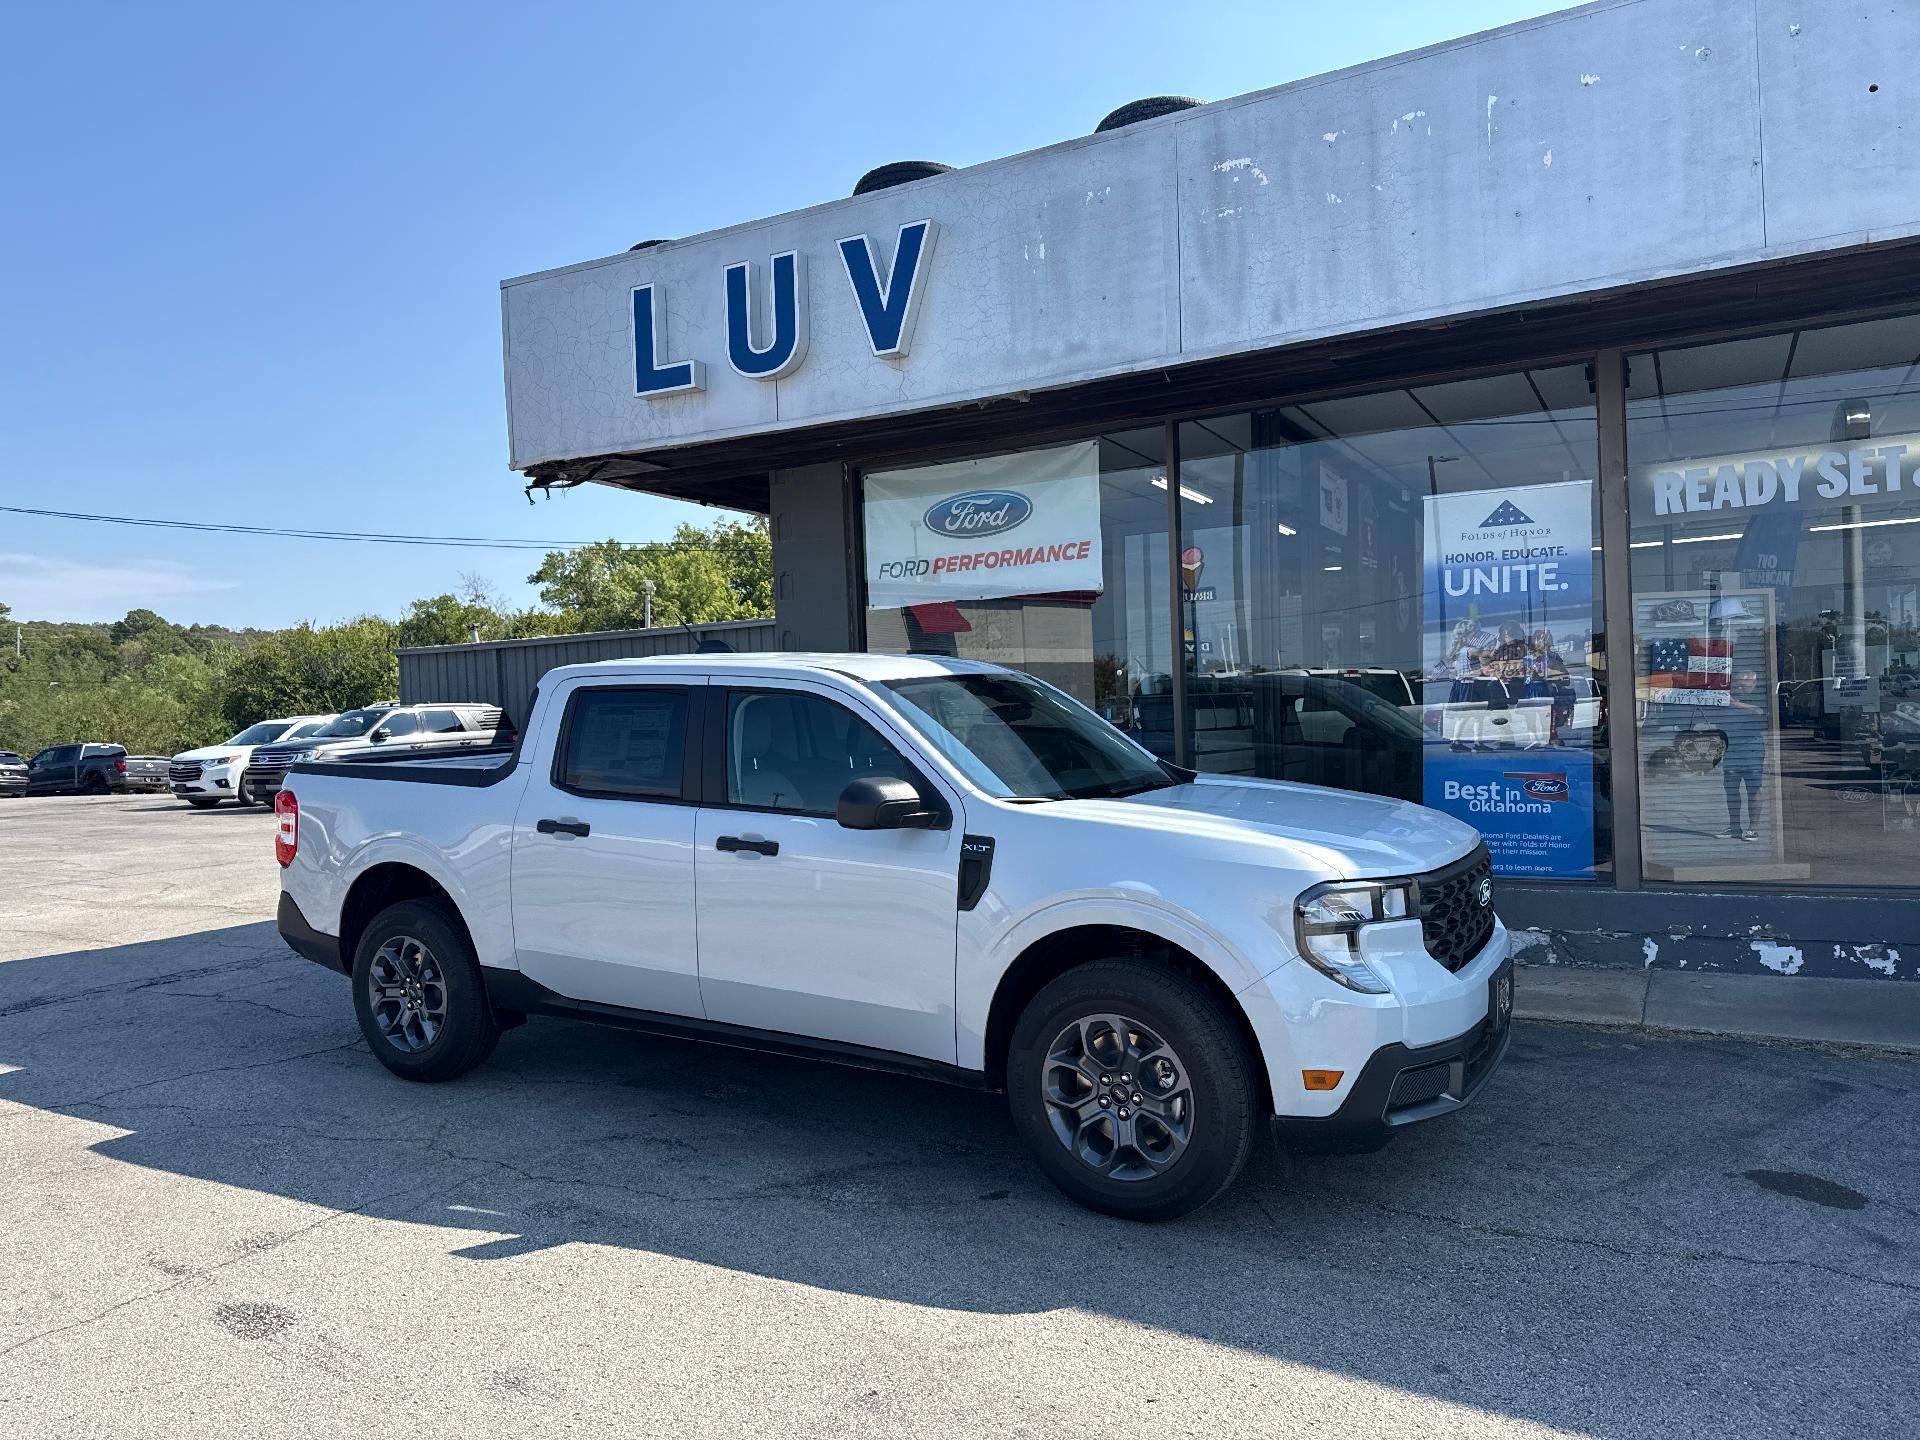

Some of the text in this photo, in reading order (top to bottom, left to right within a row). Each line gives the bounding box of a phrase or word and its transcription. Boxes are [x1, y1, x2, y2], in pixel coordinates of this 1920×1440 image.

[630, 217, 940, 401] LUV
[1653, 445, 1908, 516] READY SET
[944, 497, 1011, 531] Ford
[879, 540, 1092, 579] FORD PERFORMANCE
[1445, 545, 1568, 564] HONOR. EDUCATE.
[1444, 562, 1569, 597] UNITE.
[1444, 780, 1520, 800] Best in
[1469, 800, 1552, 813] Oklahoma
[1522, 833, 1549, 841] Dealers
[963, 843, 990, 852] XLT
[1520, 848, 1549, 856] mission.
[1514, 864, 1533, 872] learn
